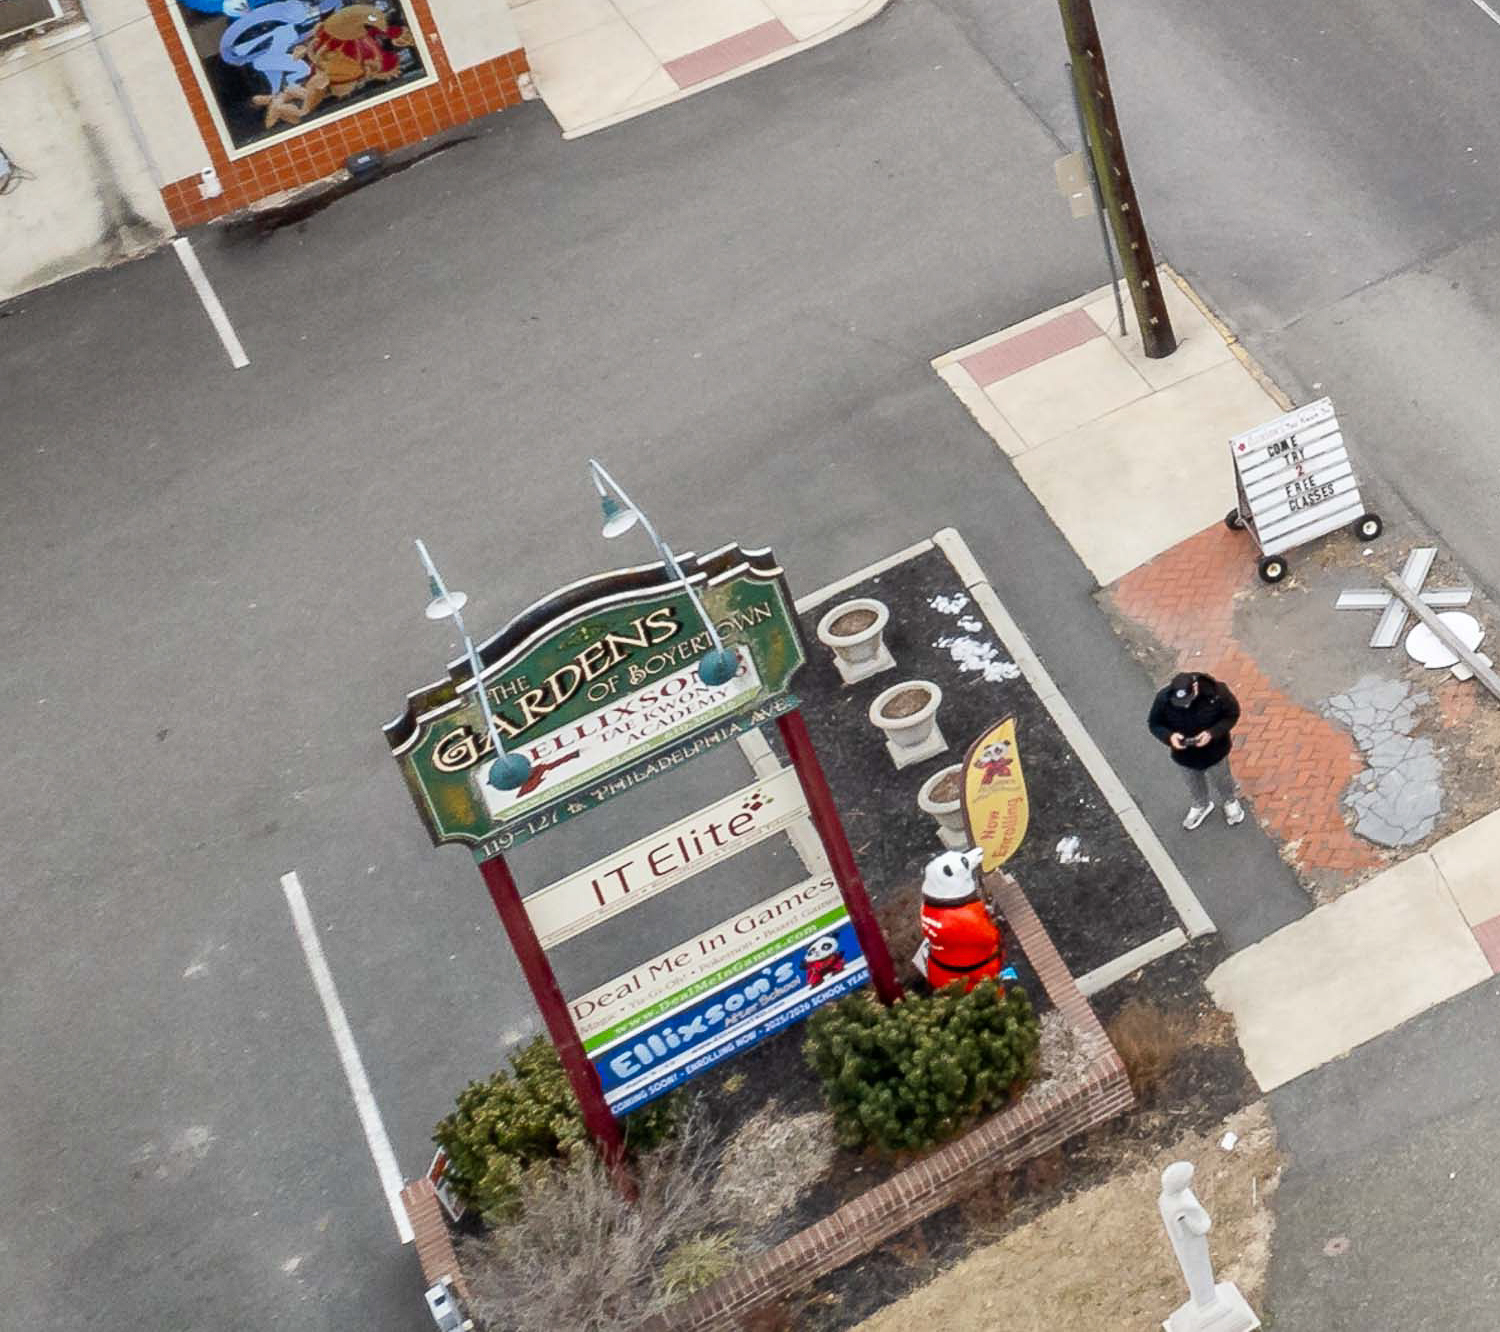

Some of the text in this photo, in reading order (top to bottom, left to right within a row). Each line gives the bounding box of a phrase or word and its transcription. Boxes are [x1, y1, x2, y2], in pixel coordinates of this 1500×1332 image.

[1267, 434, 1298, 458] COME
[1284, 447, 1305, 466] TRY
[1295, 463, 1305, 478] 2
[1285, 475, 1316, 498] FREE
[1288, 483, 1335, 512] CLASSES
[587, 601, 773, 704] OF BOYERTOWN
[432, 607, 680, 773] GARDENS
[490, 675, 530, 704] THE
[623, 686, 731, 745] ACADEMY
[589, 721, 744, 803] PHILADELPHIA
[980, 809, 1000, 841] Now
[991, 796, 1025, 860] Enrolling
[588, 860, 644, 906] IT
[643, 804, 759, 878] Elite
[570, 874, 837, 1021] Deal Me In Games
[600, 956, 806, 1082] Ellixson's
[721, 975, 804, 1028] After School
[608, 1087, 648, 1115] COMING
[682, 1040, 736, 1075] ENROLLING
[733, 1029, 758, 1048] NOW
[809, 981, 848, 1007] SCHOOL
